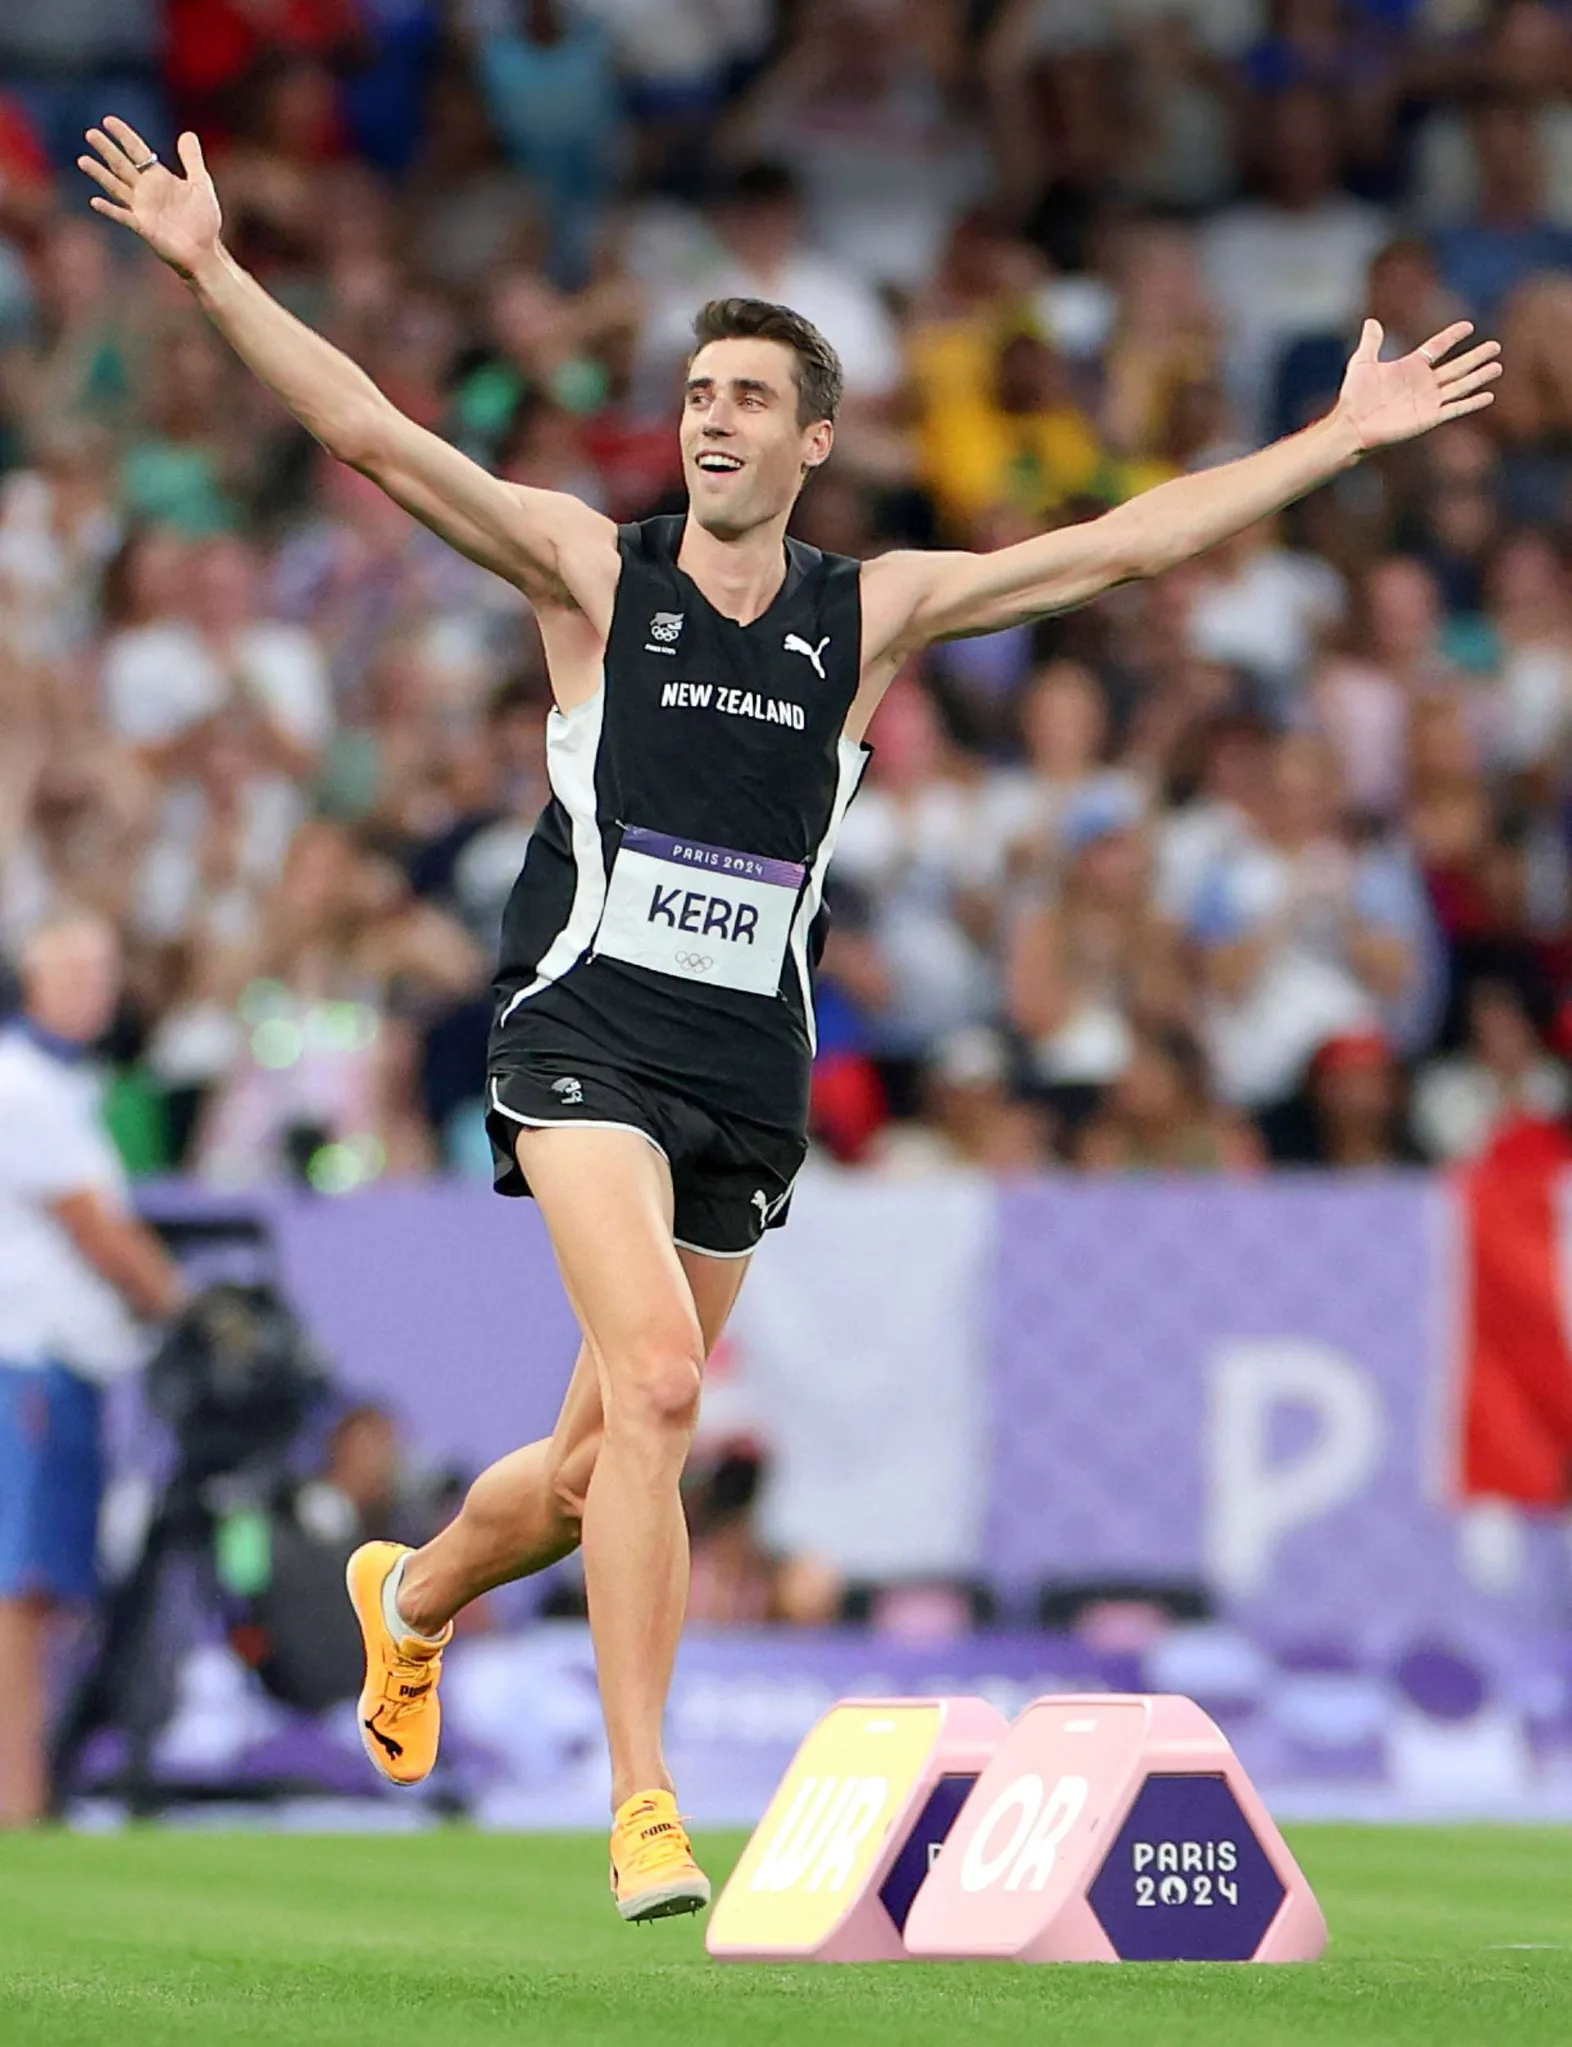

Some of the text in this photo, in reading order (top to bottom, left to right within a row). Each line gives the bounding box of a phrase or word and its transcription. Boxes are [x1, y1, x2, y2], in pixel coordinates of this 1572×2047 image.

[661, 682, 805, 730] NEW ZEALAND
[672, 844, 763, 876] PARIS 2024
[647, 884, 759, 945] KERR
[640, 1822, 675, 1841] PUM
[747, 1776, 887, 1892] WR
[960, 1774, 1089, 1893] OR
[1135, 1875, 1238, 1907] 2024
